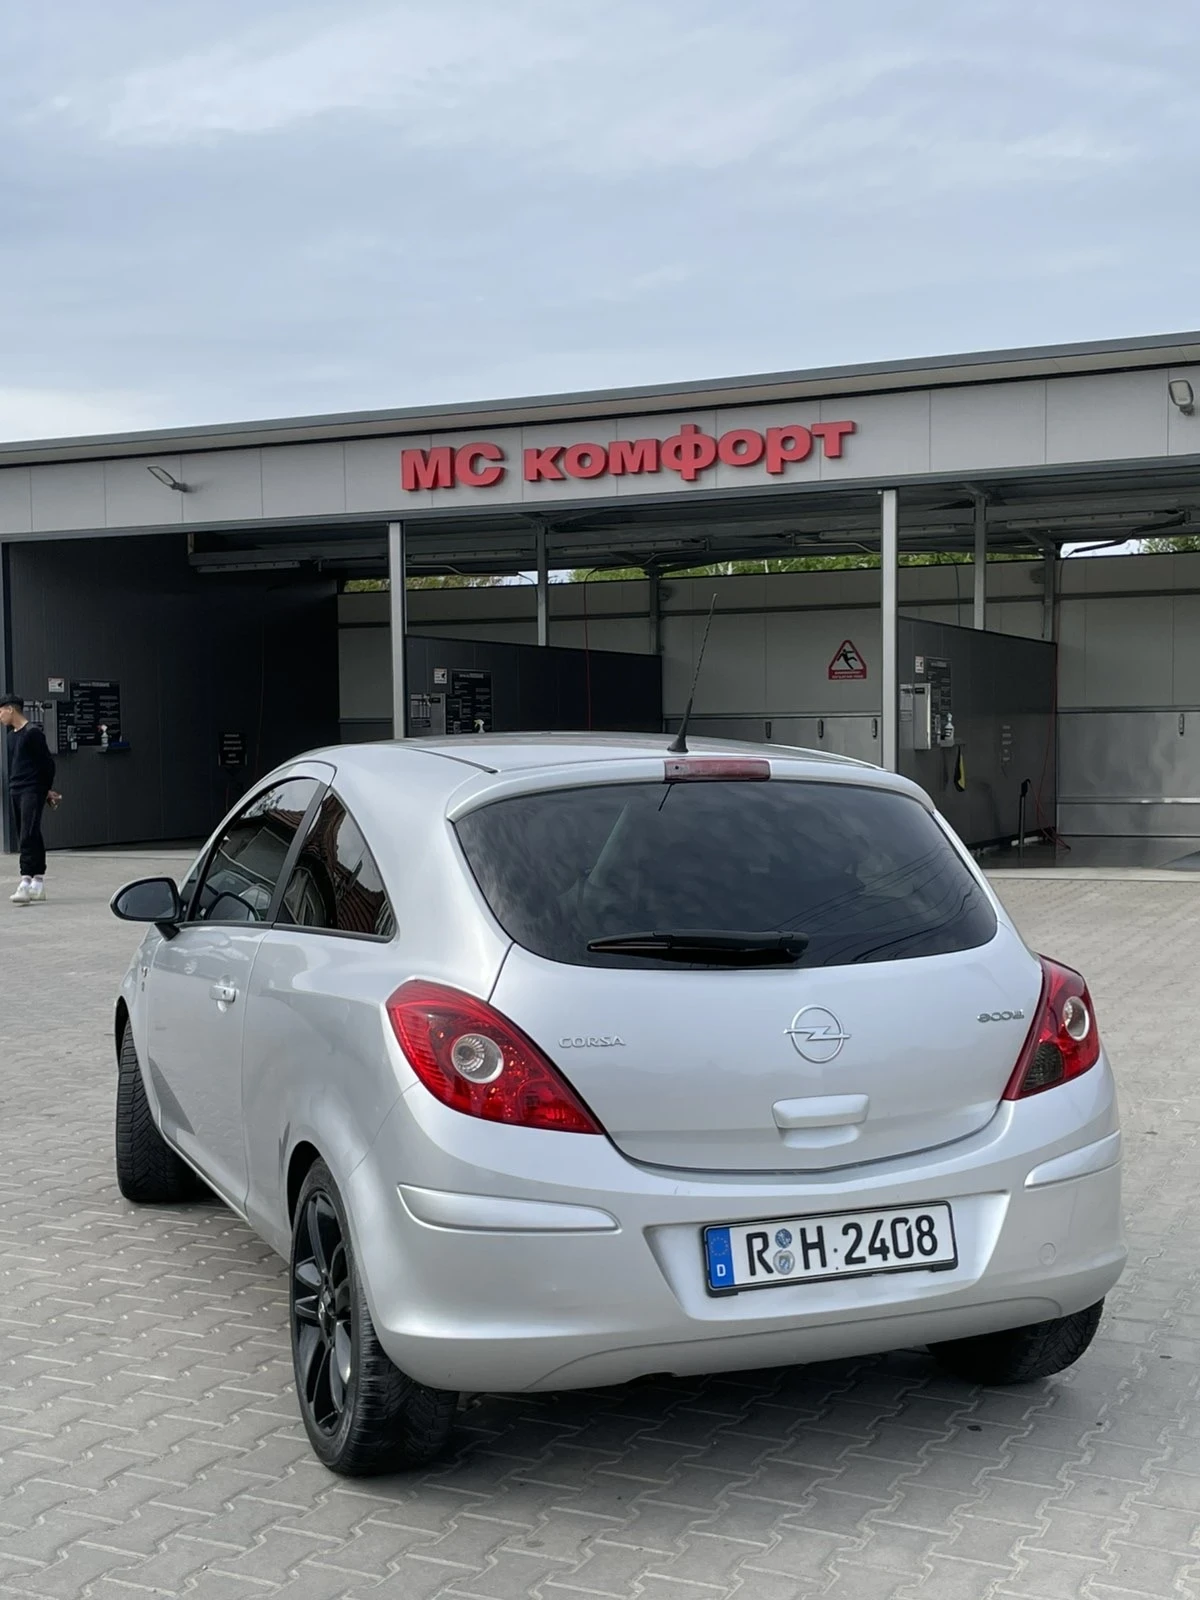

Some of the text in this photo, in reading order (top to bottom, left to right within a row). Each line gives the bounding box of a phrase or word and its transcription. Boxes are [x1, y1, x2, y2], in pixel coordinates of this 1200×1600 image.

[401, 420, 856, 491] МС комфорт
[559, 1036, 626, 1049] CORSA
[716, 1263, 726, 1277] D
